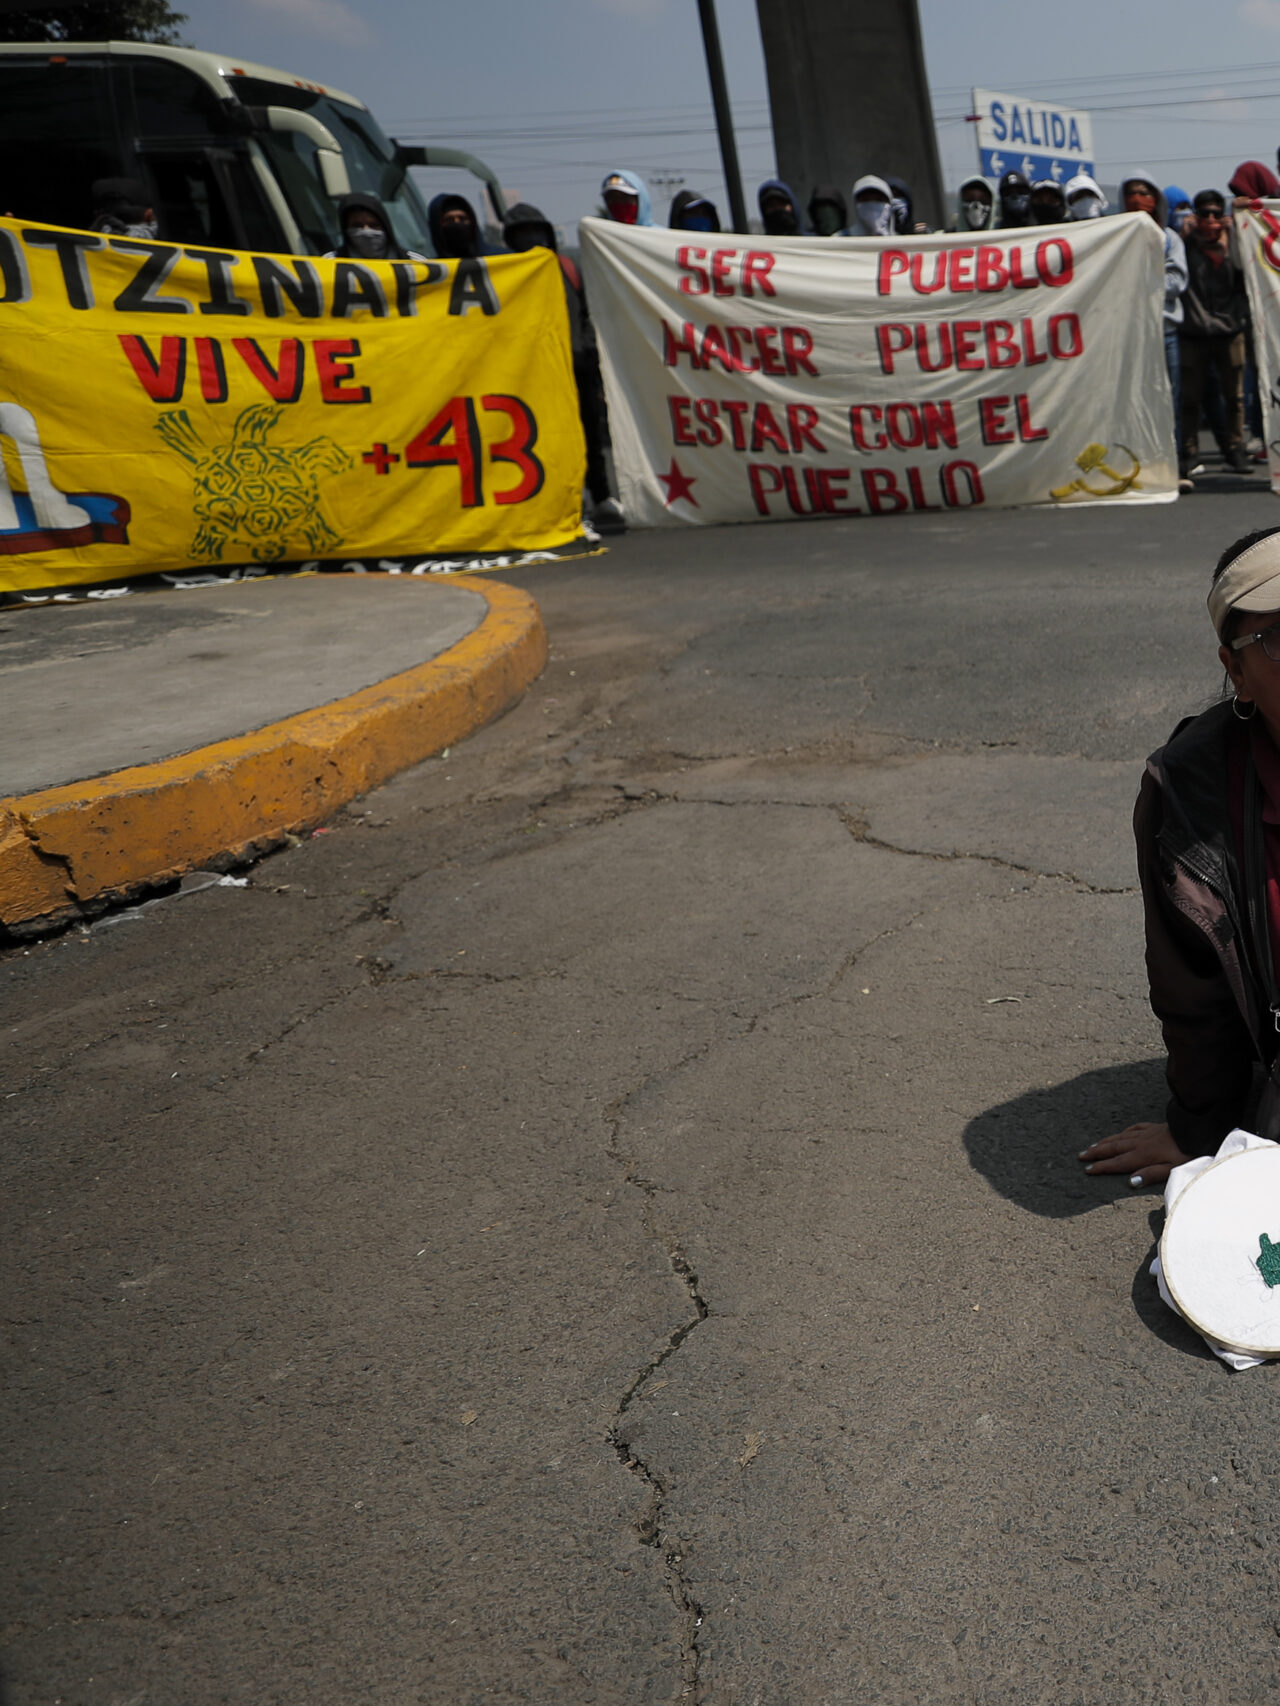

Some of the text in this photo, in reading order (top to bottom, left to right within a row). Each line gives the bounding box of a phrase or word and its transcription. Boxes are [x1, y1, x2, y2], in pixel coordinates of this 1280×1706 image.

[991, 101, 1082, 153] SALIDA
[675, 237, 1075, 298] SER PUEBLO
[117, 334, 372, 404] VIVE
[660, 311, 1085, 377] HACER PUEBLO
[666, 392, 1049, 454] ESTAR CON EL
[747, 458, 986, 517] PUEBLO
